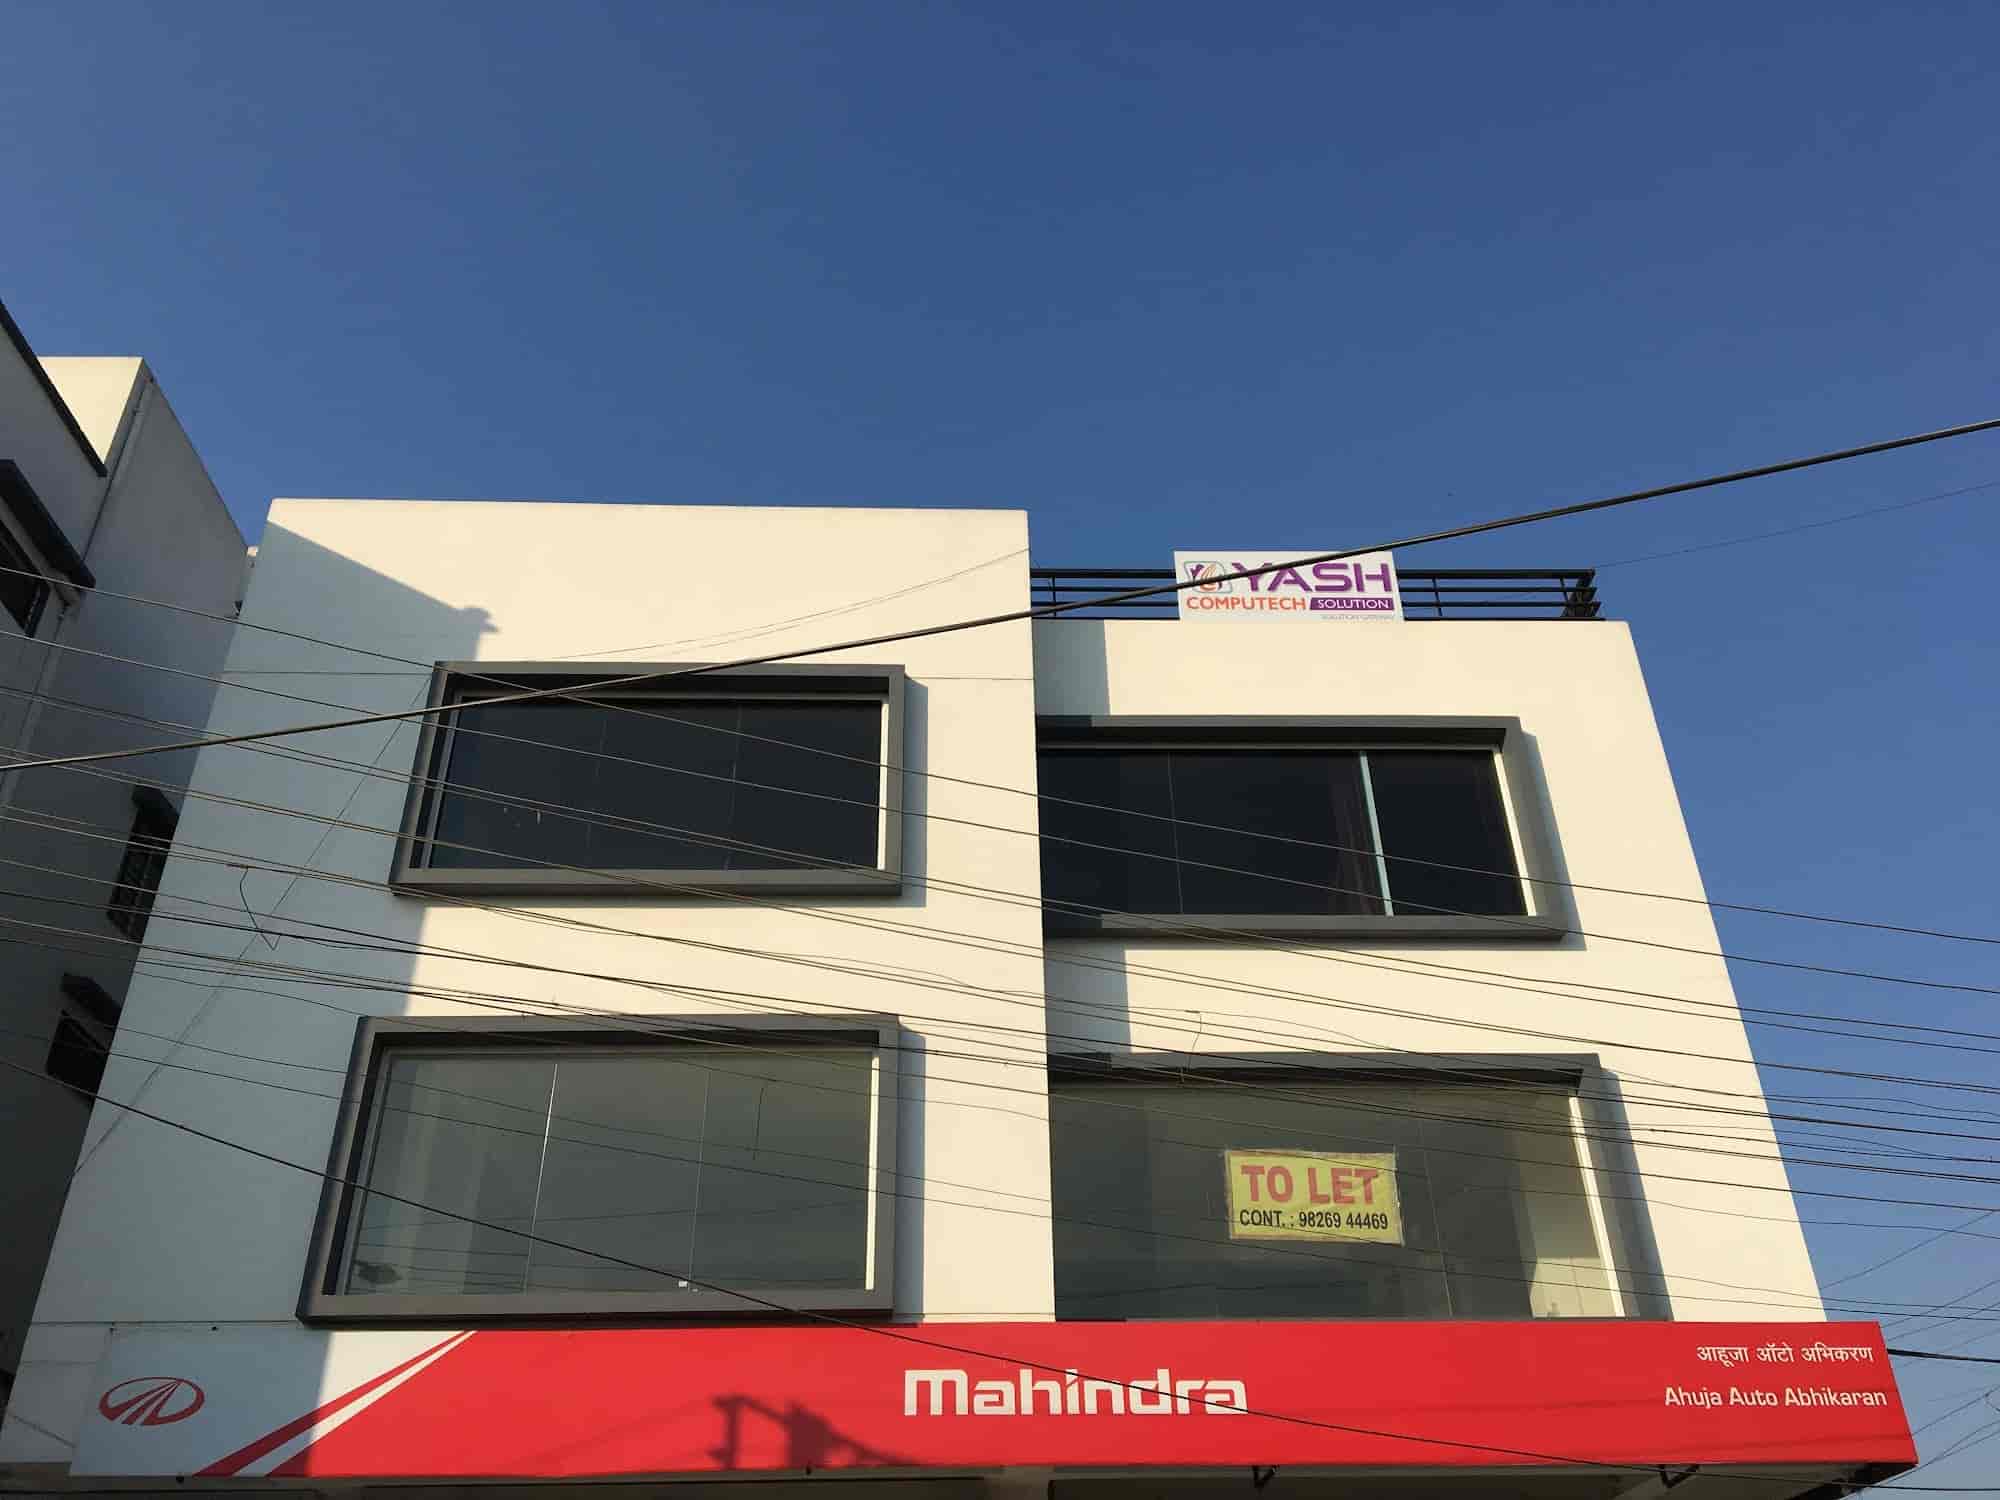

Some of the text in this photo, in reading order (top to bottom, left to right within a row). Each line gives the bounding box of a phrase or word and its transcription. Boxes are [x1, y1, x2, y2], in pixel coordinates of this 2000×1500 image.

[1231, 562, 1393, 592] YASH
[1186, 596, 1389, 610] COMPUTECH SOLUTION
[1240, 1165, 1379, 1205] TO LET
[1299, 1211, 1341, 1229] 98269
[1346, 1213, 1389, 1230] 44469
[1696, 1342, 1873, 1367] आहूजा ऑटो अभिकरण
[903, 1368, 1249, 1416] Mahindra
[1664, 1386, 1888, 1409] Ahuja Auto Abhikaran
